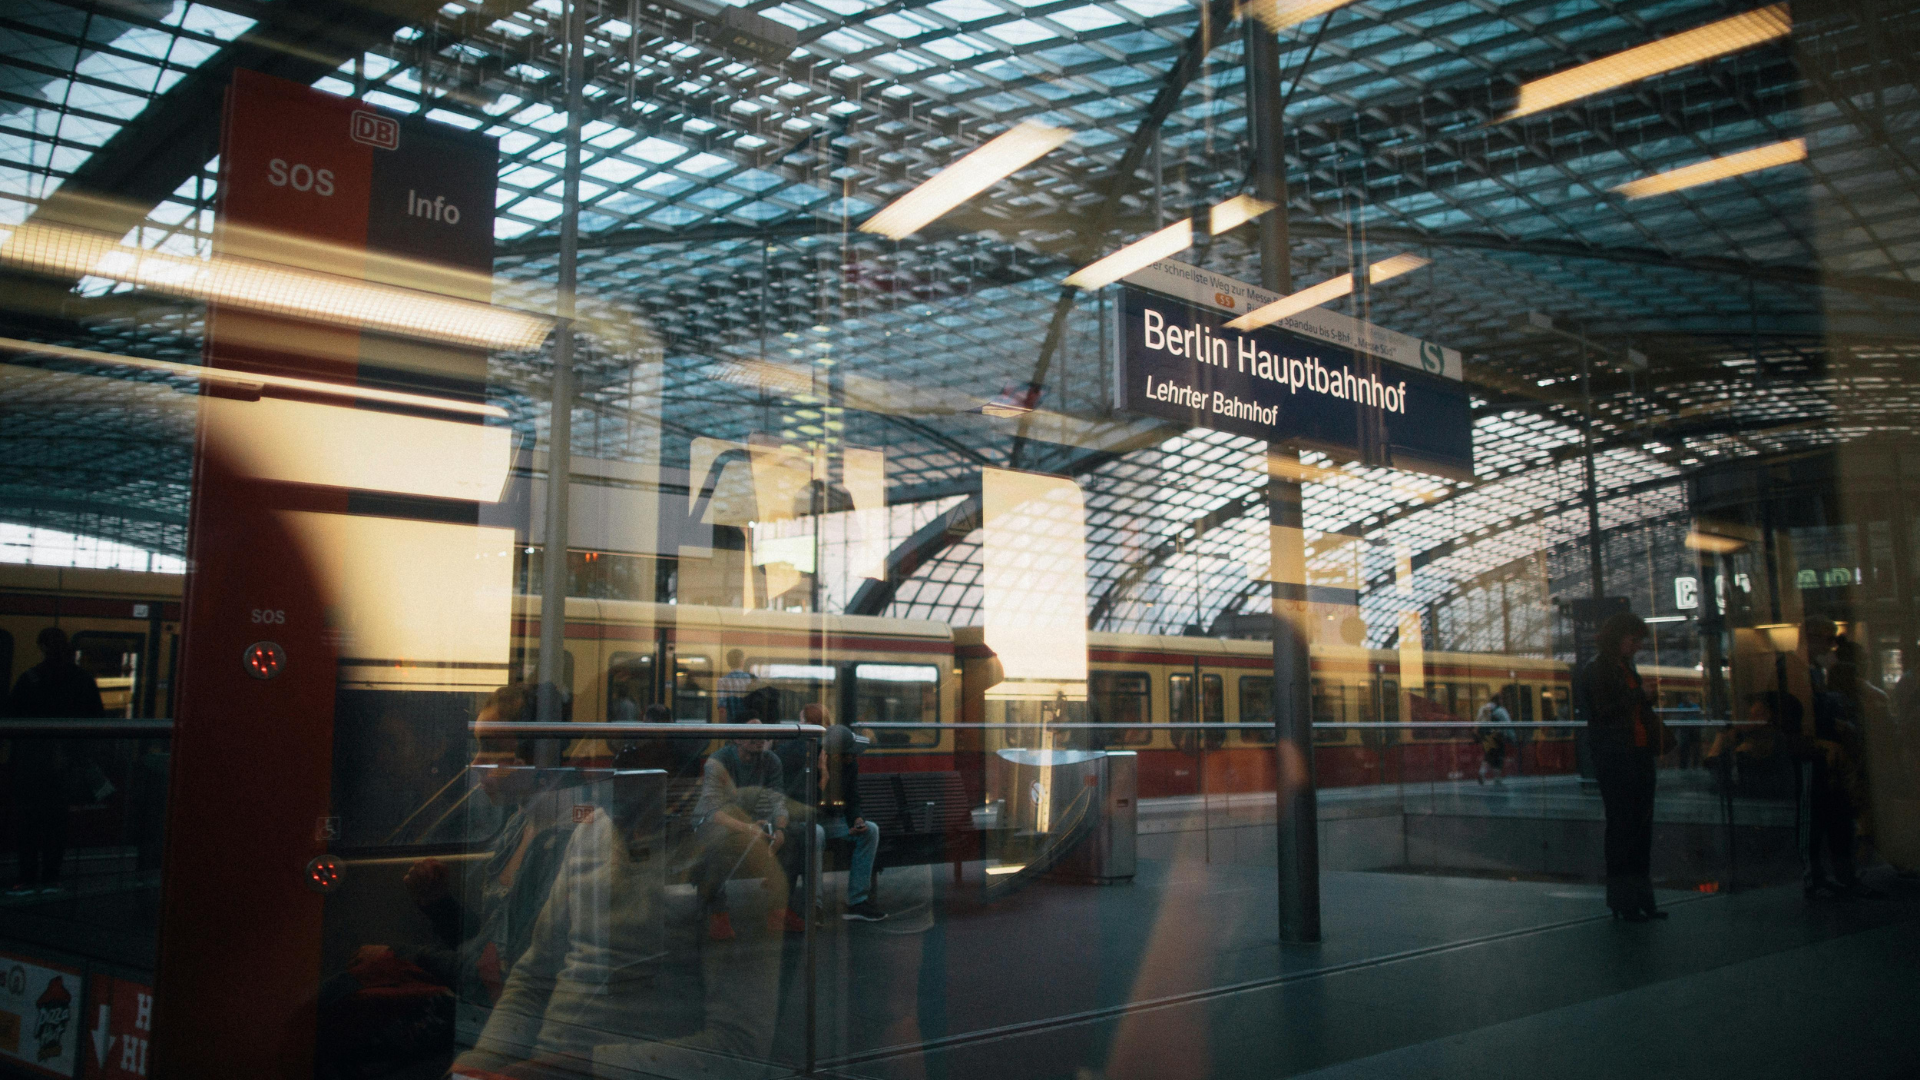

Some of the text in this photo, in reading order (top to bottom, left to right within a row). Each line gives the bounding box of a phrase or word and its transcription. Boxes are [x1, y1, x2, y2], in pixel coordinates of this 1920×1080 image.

[267, 157, 335, 197] SOS
[407, 188, 461, 225] Info
[1164, 263, 1209, 286] schnellste
[1209, 275, 1230, 294] Weg
[1231, 284, 1245, 297] zur
[1246, 287, 1272, 303] Messe
[1319, 323, 1330, 338] bis
[1143, 308, 1406, 414] Berlin Hauptbahnhof
[1421, 340, 1444, 376] S
[1145, 375, 1278, 426] Lehrter Bahnhof
[251, 608, 286, 625] SOS
